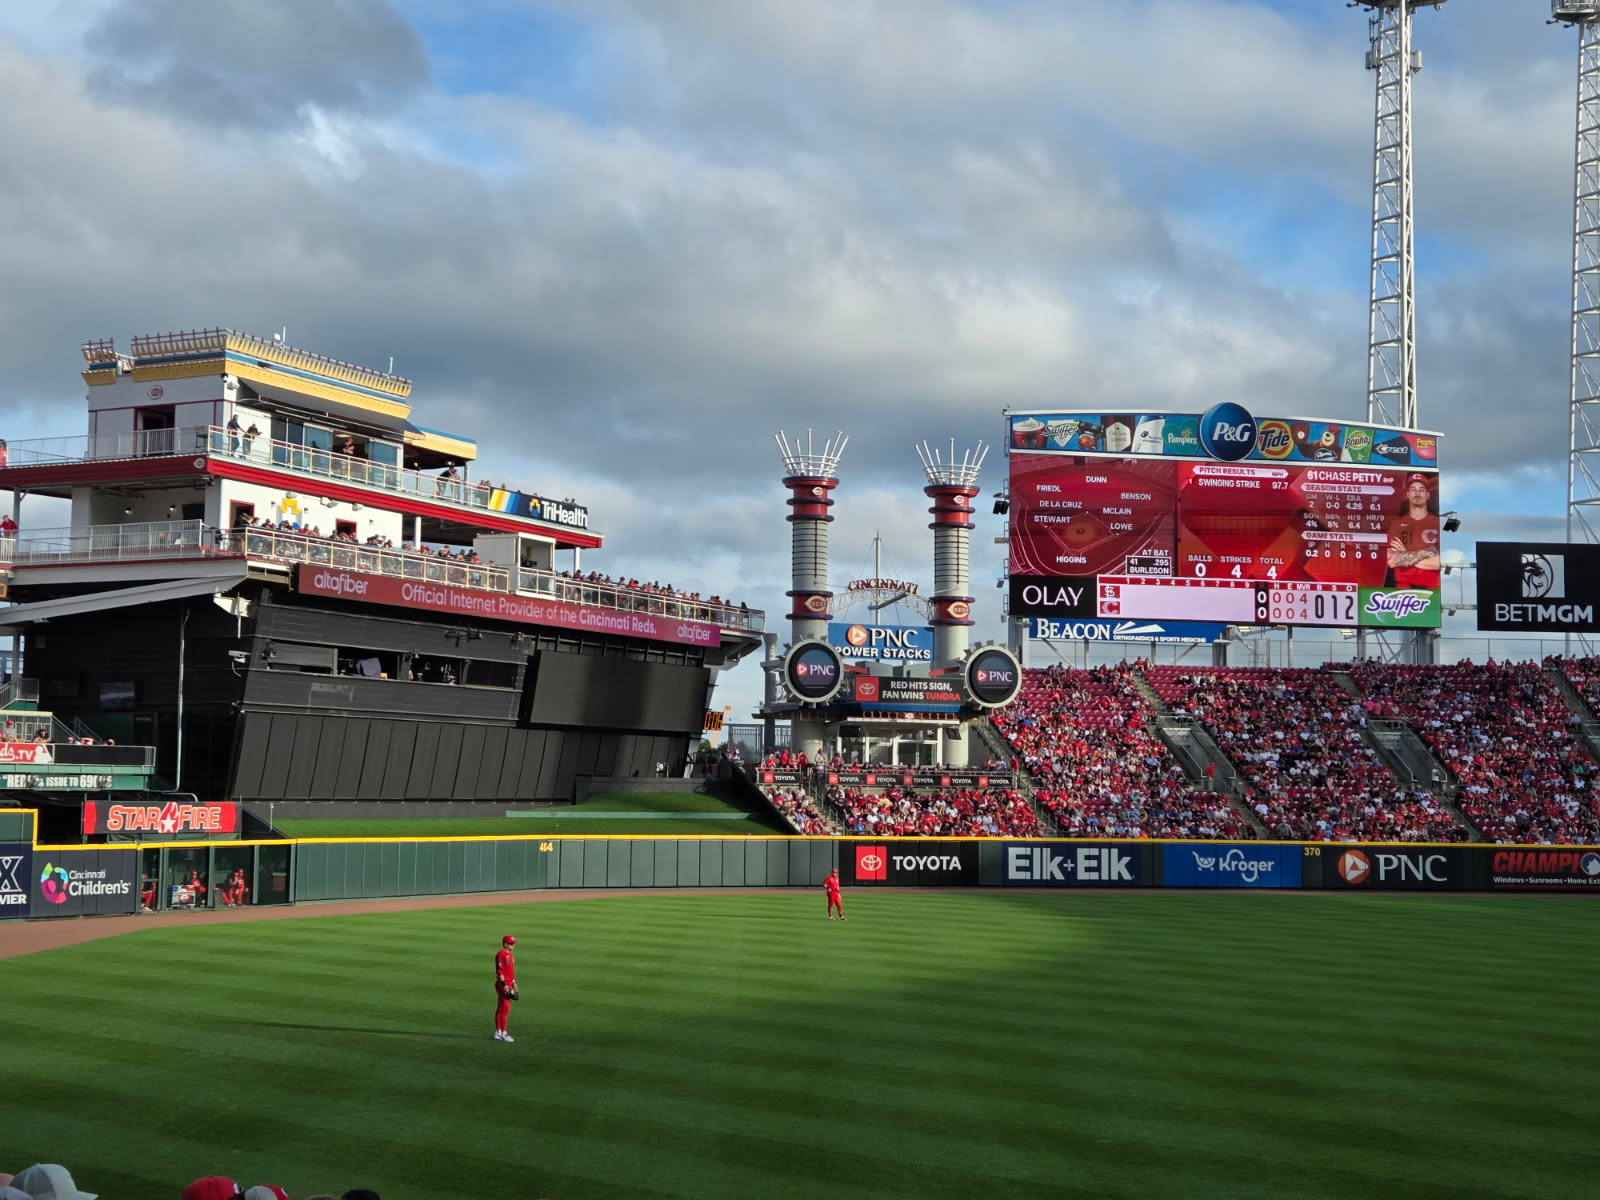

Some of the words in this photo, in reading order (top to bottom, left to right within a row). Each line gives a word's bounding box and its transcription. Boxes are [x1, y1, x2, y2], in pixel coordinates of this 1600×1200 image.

[1041, 424, 1079, 439] Swiffer
[1212, 422, 1251, 441] P&G
[1168, 433, 1197, 445] Pampers
[1260, 429, 1290, 451] Tide
[1345, 435, 1371, 449] Bounty
[1223, 467, 1256, 475] RESULTS
[1307, 470, 1318, 480] 61
[1319, 471, 1352, 481] CHASE
[1353, 472, 1382, 483] PETTY
[1085, 476, 1107, 484] DUNN
[1198, 478, 1234, 487] SWINGING
[1236, 480, 1261, 489] STRIKE
[1272, 481, 1288, 490] 97.7
[1121, 493, 1151, 501] BENSON
[1062, 501, 1083, 509] CRUZ
[1103, 507, 1132, 515] MCLAIN
[541, 500, 588, 527] TriHealth
[1034, 515, 1071, 523] STEWART
[1330, 533, 1354, 541] STATS
[1056, 556, 1087, 564] HIGGINS
[1188, 554, 1213, 562] BALLS
[1220, 556, 1252, 564] STRIKES
[1259, 557, 1284, 565] TOTAL
[1305, 549, 1319, 557] 0.2
[1324, 550, 1331, 558] 0
[1340, 550, 1346, 559] 0
[1355, 551, 1362, 559] 0
[1371, 551, 1377, 560] 0
[1129, 566, 1169, 575] BURLESON
[1195, 563, 1206, 577] 0
[1230, 564, 1242, 579] 4
[1266, 565, 1277, 580] 4
[848, 578, 919, 594] CINCINNATI
[1022, 585, 1083, 606] OLAY
[1257, 591, 1267, 603] 0
[1272, 592, 1281, 604] 0
[1286, 592, 1294, 604] 0
[1300, 593, 1308, 604] 4
[314, 571, 369, 595] altafiber
[402, 583, 447, 605] Official
[450, 590, 496, 613] Internet
[499, 597, 544, 619] Provider
[546, 605, 558, 620] of
[559, 607, 577, 623] the
[579, 609, 629, 630] Cincinnati
[631, 616, 657, 634] Reds.
[677, 621, 711, 642] altafiber
[1365, 592, 1430, 618] Swiffer
[1257, 606, 1267, 619] 0
[1272, 607, 1281, 619] 0
[1286, 608, 1294, 619] 0
[1300, 608, 1308, 620] 4
[1495, 603, 1593, 623] BETMGM
[1036, 618, 1111, 640] BEACON
[869, 628, 918, 648] PNC
[835, 646, 878, 657] POWER
[883, 648, 931, 659] STACKS
[809, 664, 835, 676] PNC
[988, 671, 1013, 682] PNC
[890, 681, 908, 689] RED
[909, 681, 928, 690] HITS
[929, 682, 953, 692] SIGN,
[882, 690, 899, 699] FAN
[900, 691, 924, 700] WINS
[925, 692, 961, 701] TUNDRA
[46, 776, 68, 787] ISSUE
[70, 776, 79, 787] TO
[107, 804, 161, 831] STAR
[178, 804, 221, 830] FIRE
[539, 841, 554, 852] 404
[1304, 847, 1321, 857] 370
[892, 855, 962, 871] TOYOTA
[1219, 849, 1275, 882] Kroger
[1375, 854, 1448, 882] PNC
[69, 870, 106, 880] Cincinnati
[1493, 876, 1525, 884] Windows
[69, 880, 129, 896] Children's
